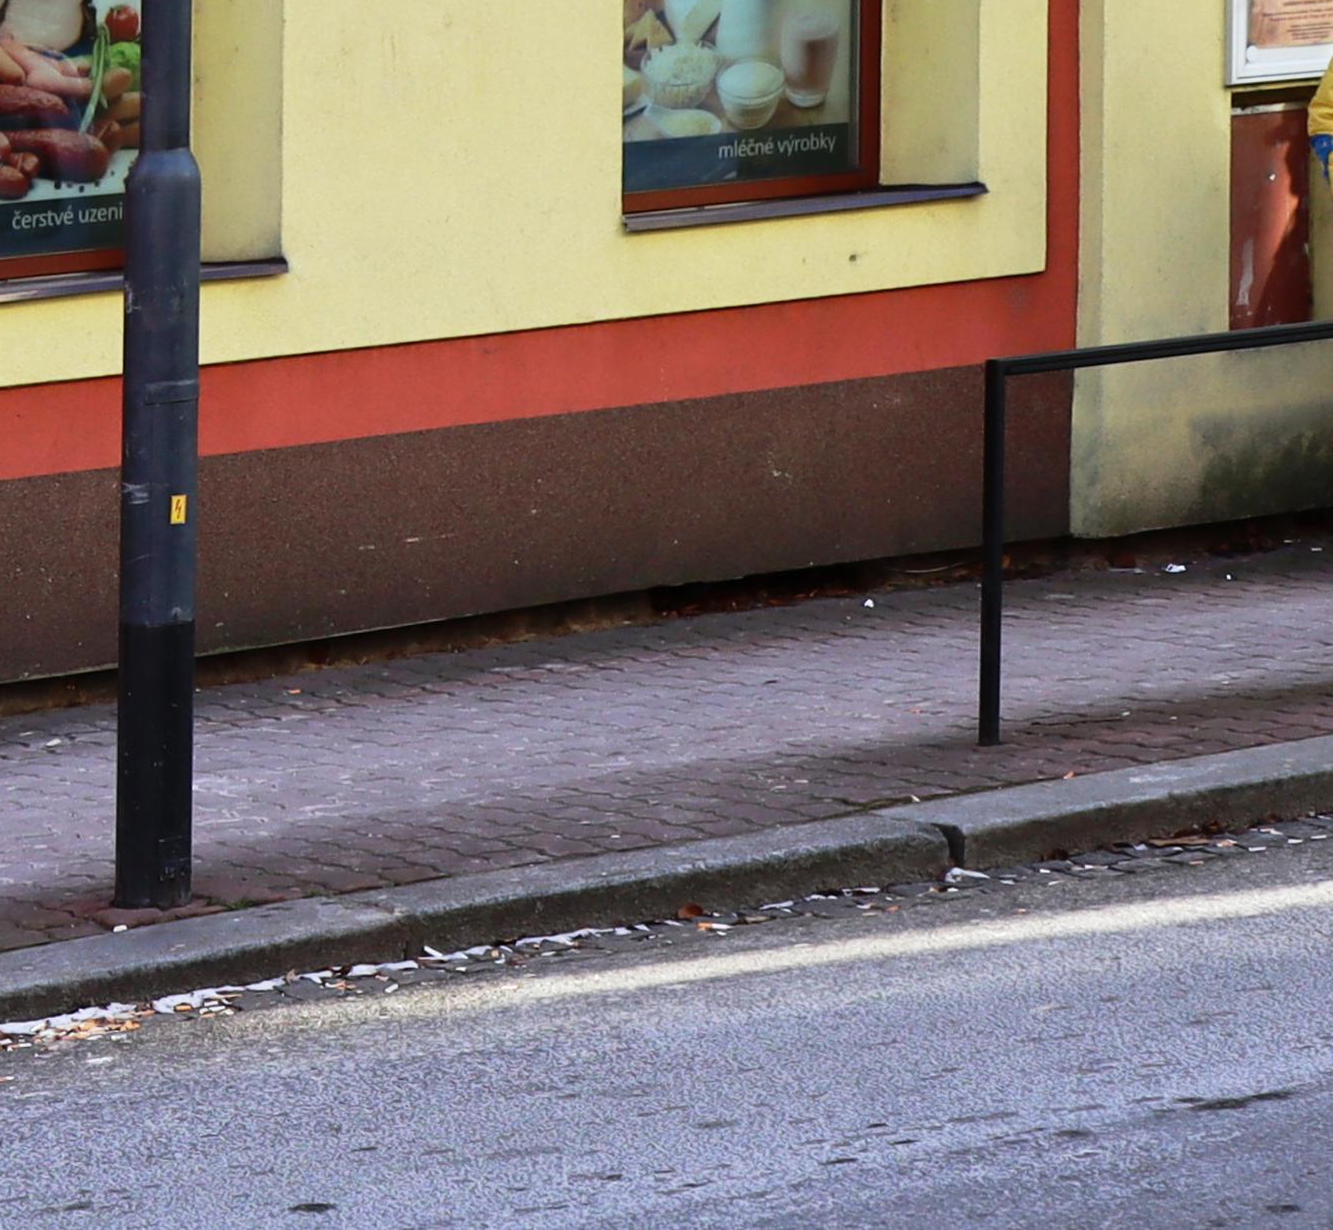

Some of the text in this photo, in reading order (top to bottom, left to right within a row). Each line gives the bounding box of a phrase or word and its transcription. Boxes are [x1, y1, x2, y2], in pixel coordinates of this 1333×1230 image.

[718, 132, 837, 160] mléčné výrobky
[12, 202, 124, 230] čerstvé uzeni
